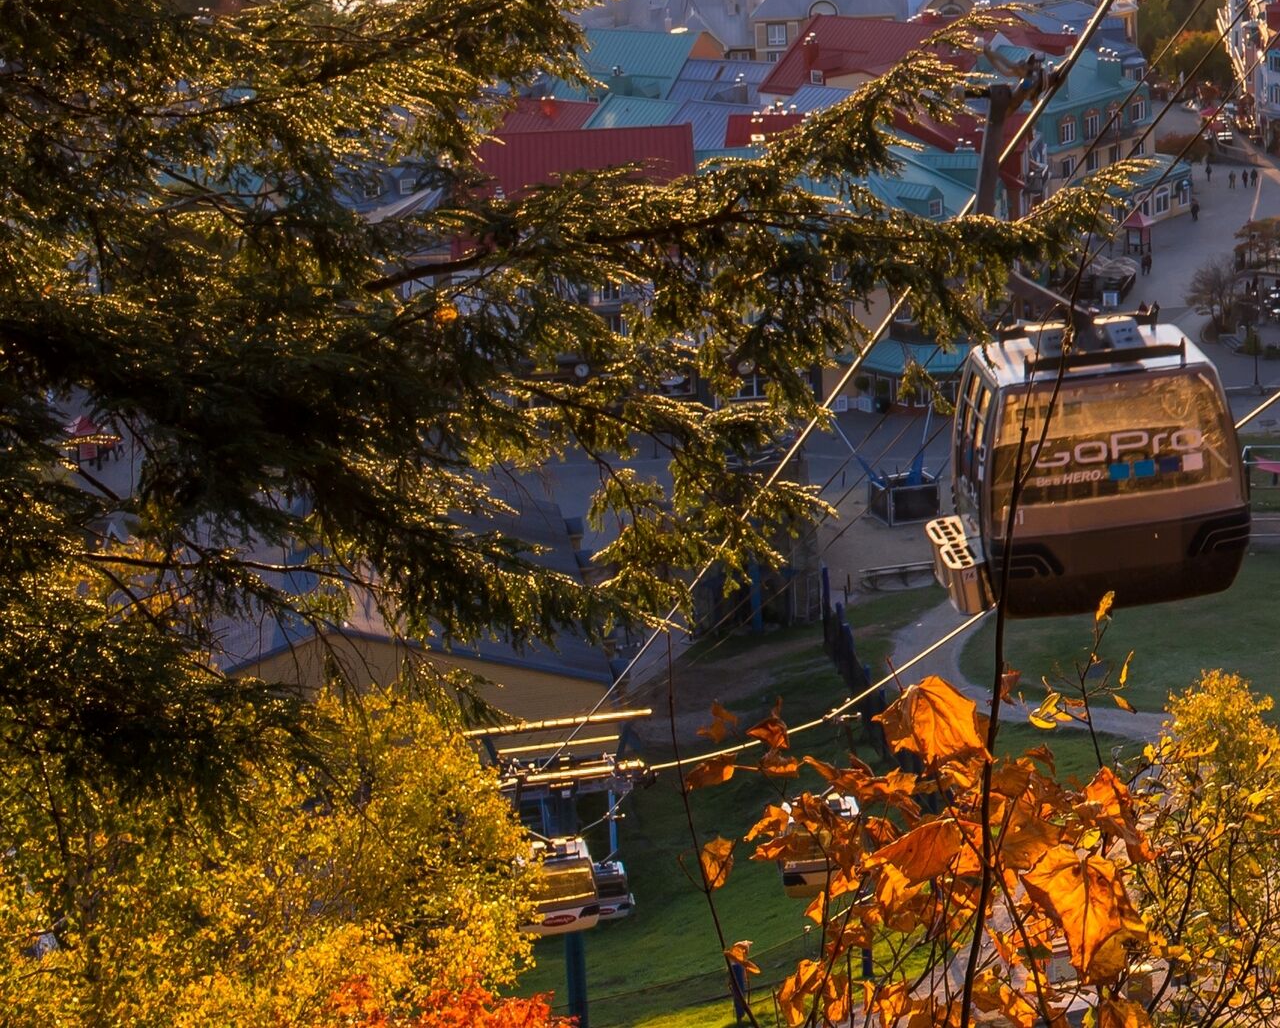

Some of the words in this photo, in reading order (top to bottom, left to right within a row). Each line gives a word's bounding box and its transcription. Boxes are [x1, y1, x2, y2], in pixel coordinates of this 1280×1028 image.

[1030, 428, 1202, 468] GoPro
[1036, 476, 1051, 487] Be
[1062, 470, 1105, 485] HERO.
